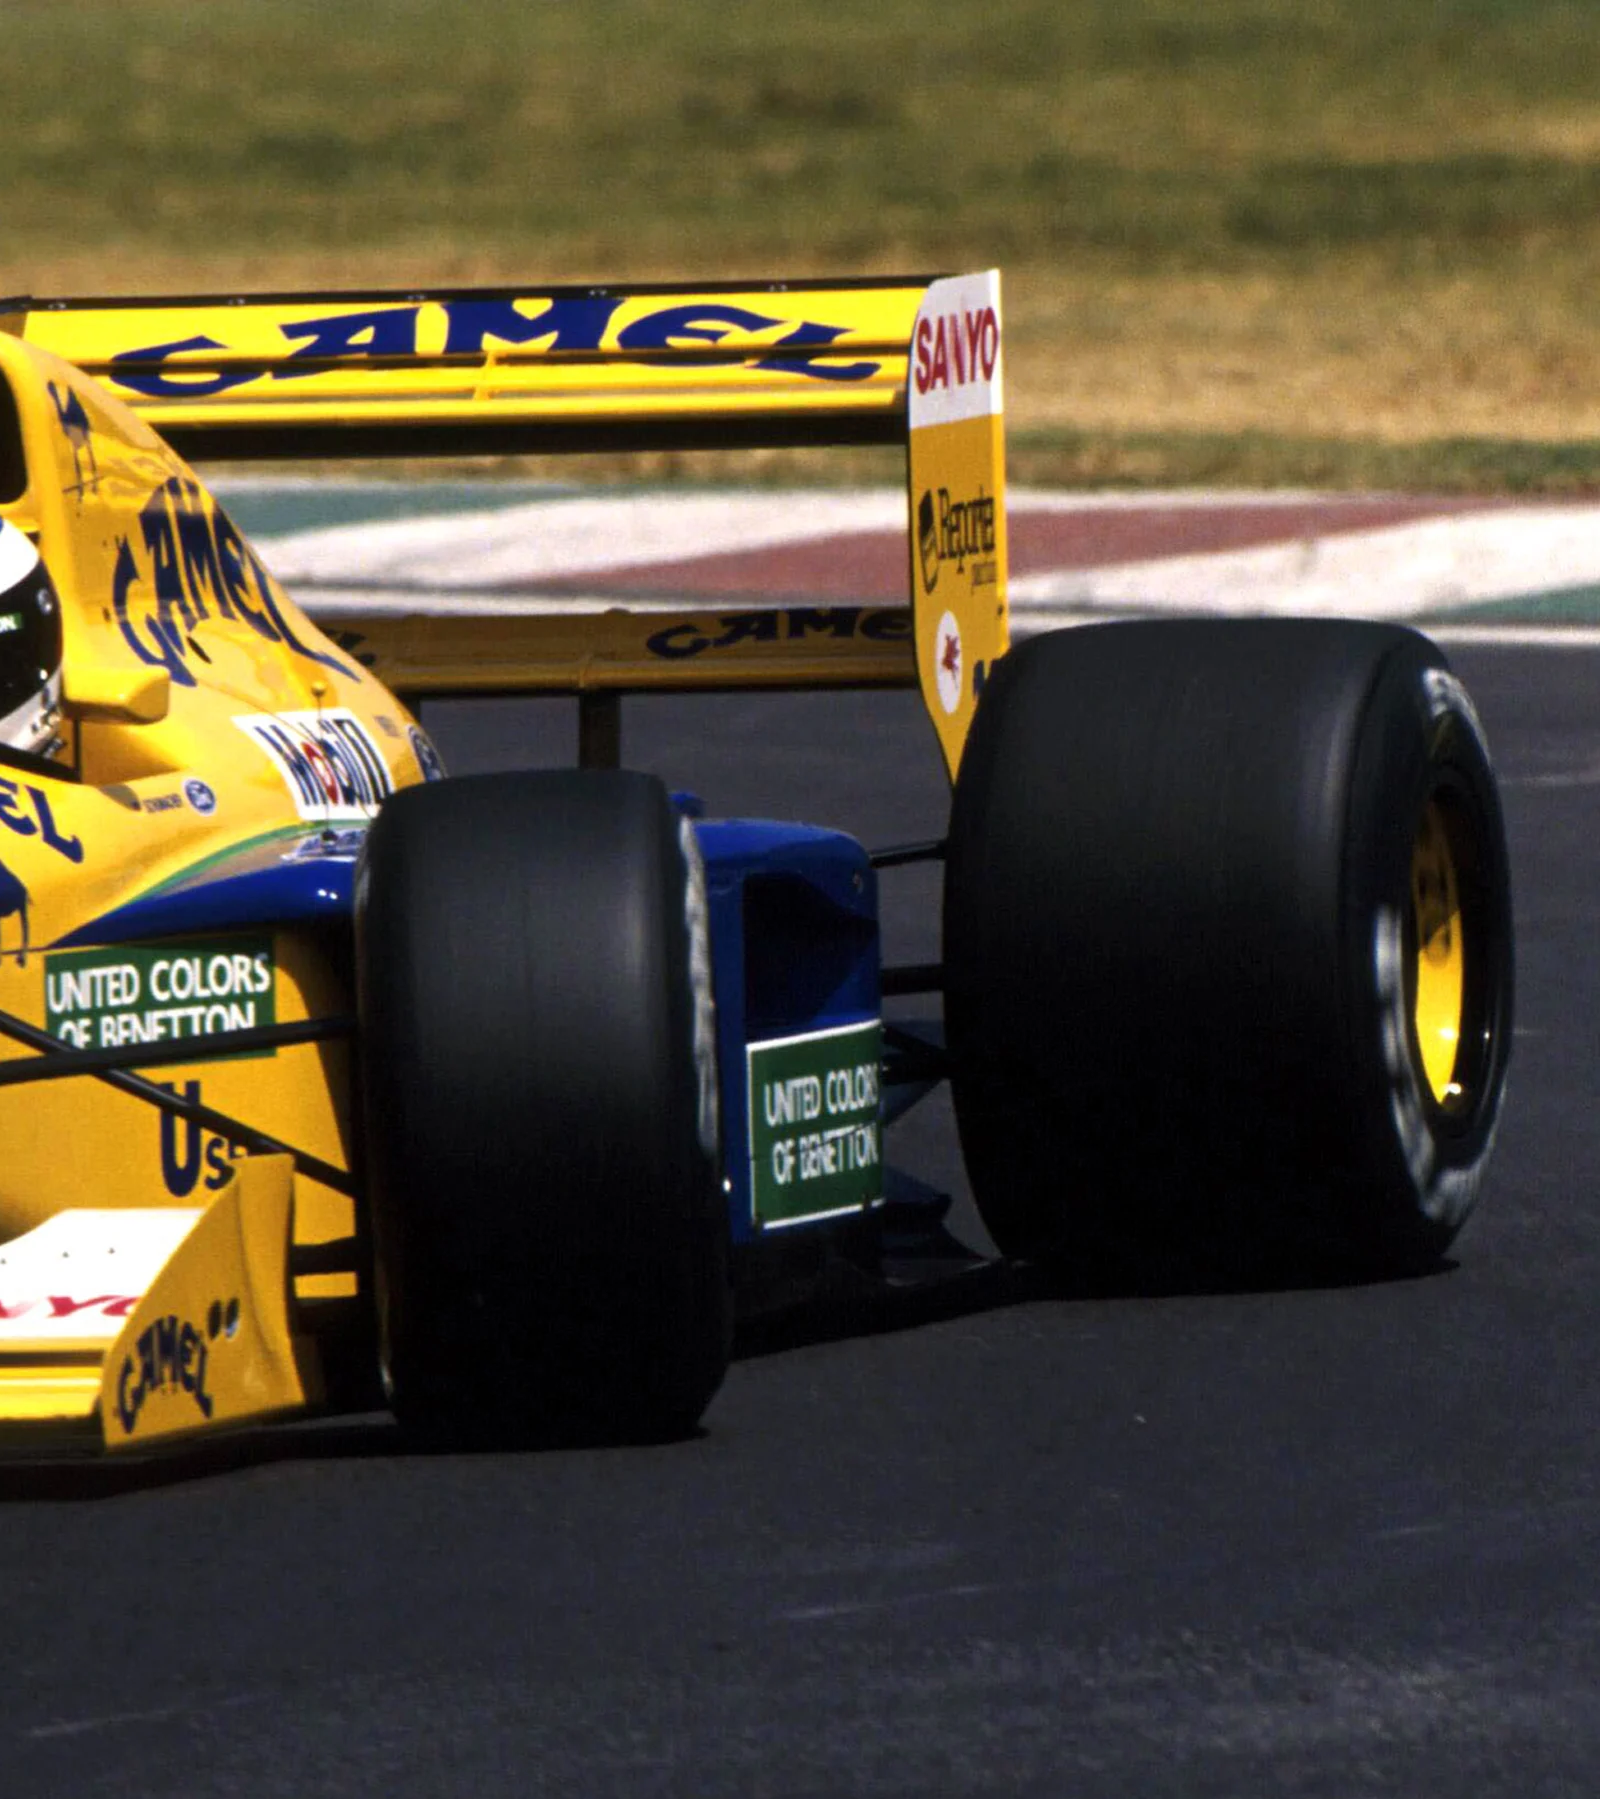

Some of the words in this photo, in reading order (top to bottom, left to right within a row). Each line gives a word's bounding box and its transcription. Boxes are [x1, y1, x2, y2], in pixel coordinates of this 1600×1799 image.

[111, 298, 882, 397] CAMEL
[915, 306, 999, 395] SANYO
[113, 476, 361, 688] CAMEL
[646, 607, 914, 658] CAME
[47, 964, 140, 1013] UNITED
[150, 952, 270, 1001] COLORS
[58, 1018, 92, 1050] OF
[101, 1002, 256, 1048] BENETTON
[764, 1075, 821, 1127] UNITED
[773, 1138, 795, 1185] OF
[116, 1314, 214, 1434] CAMEL
